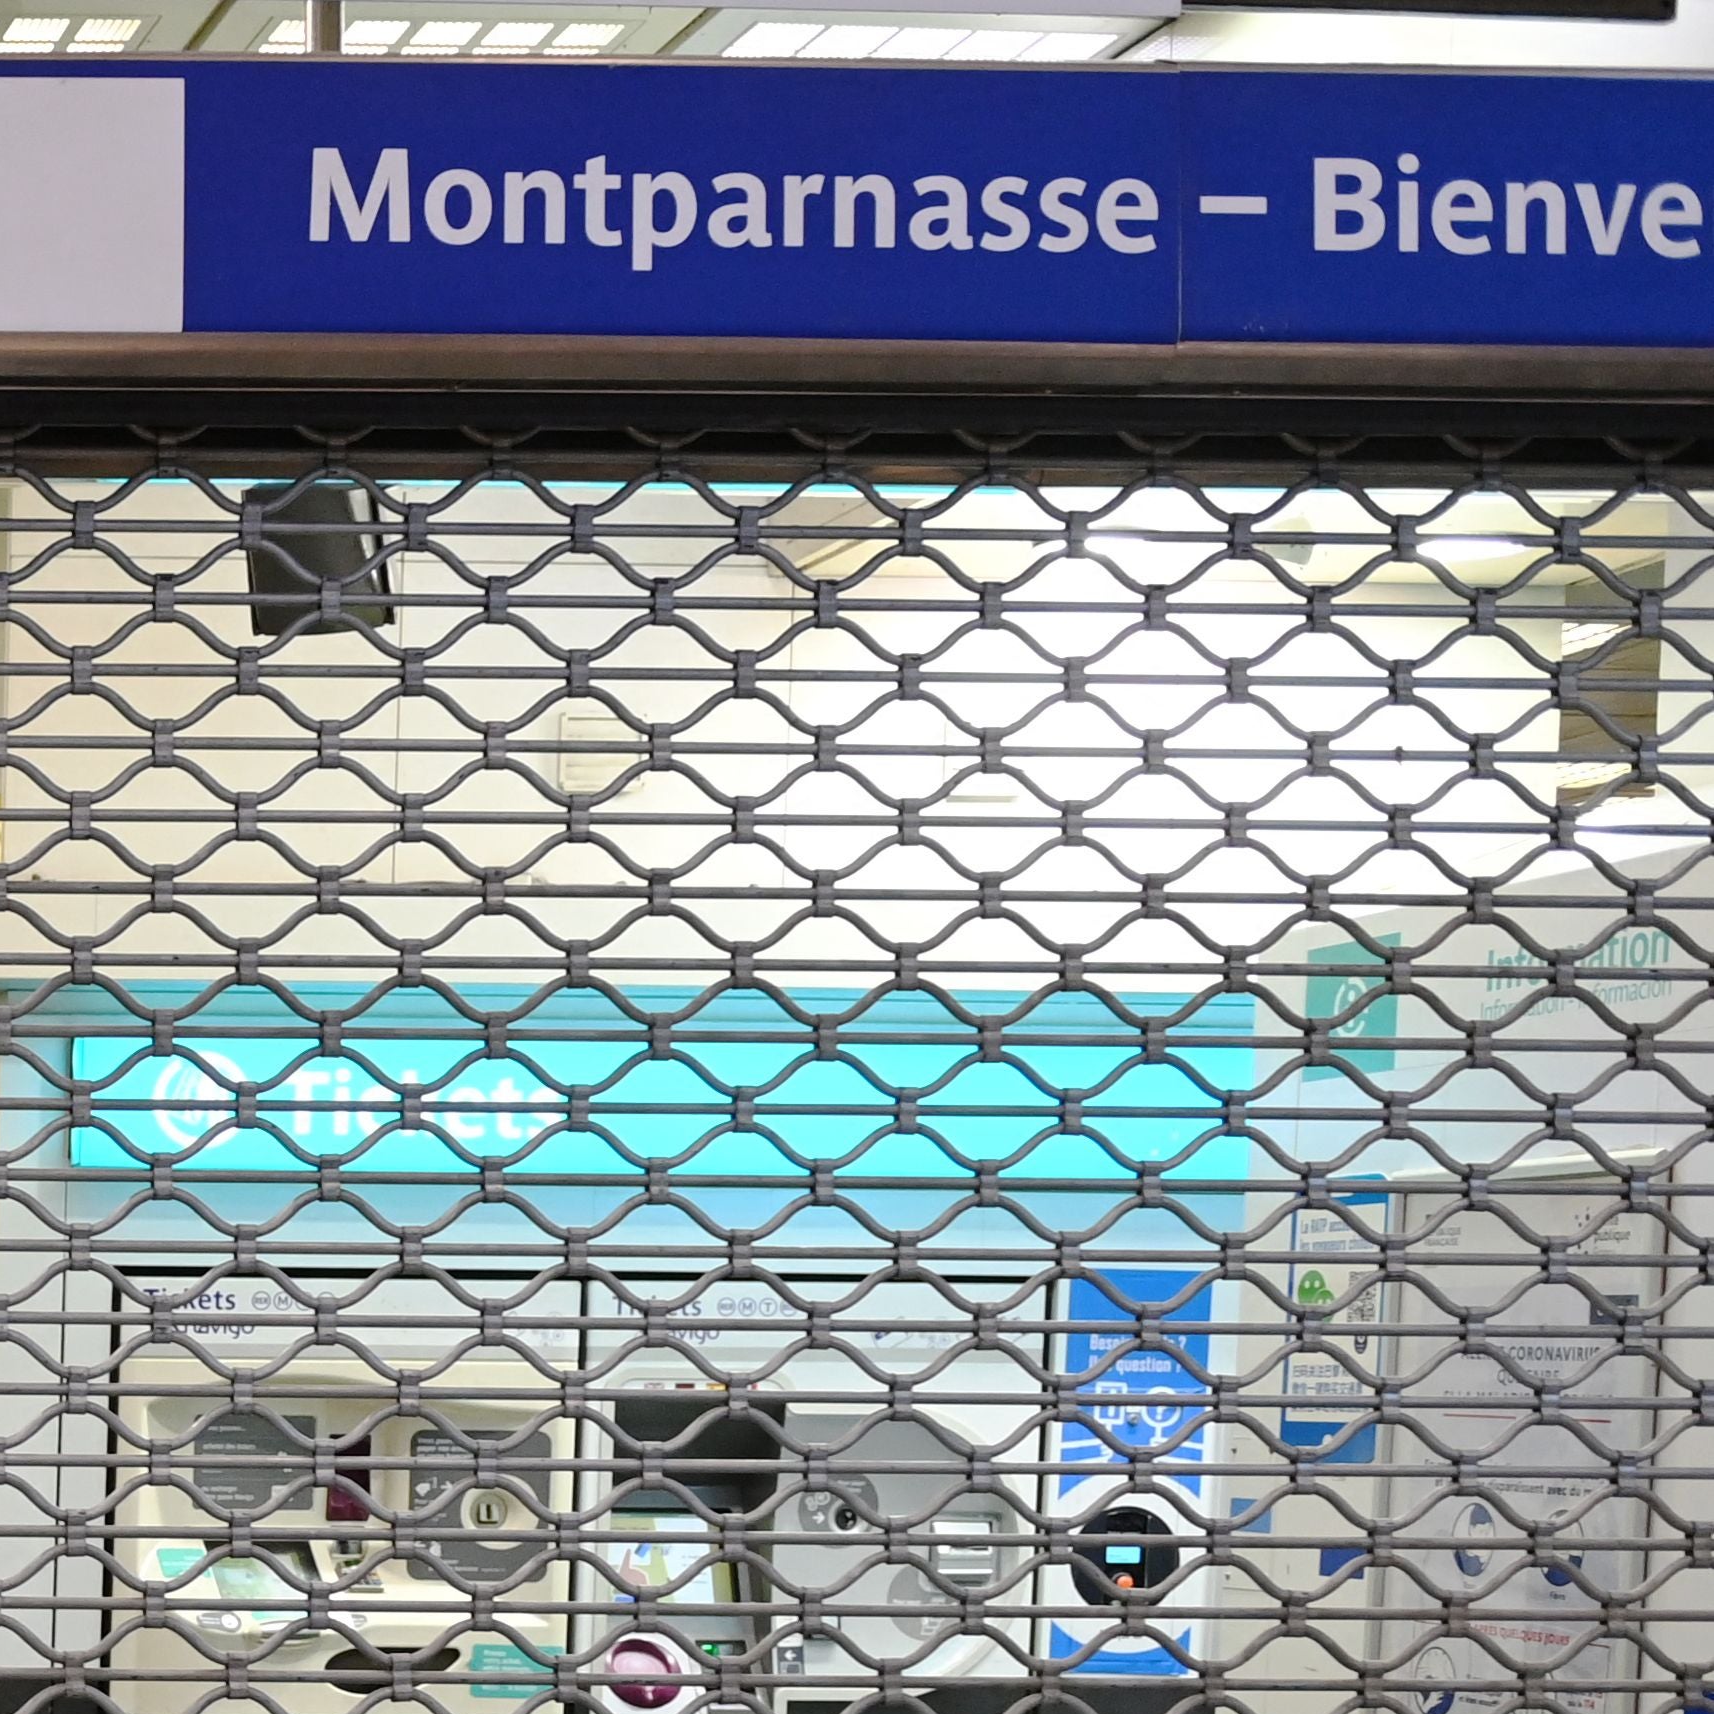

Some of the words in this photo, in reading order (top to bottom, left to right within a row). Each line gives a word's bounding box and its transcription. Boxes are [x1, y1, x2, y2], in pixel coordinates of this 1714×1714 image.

[308, 146, 1160, 272] Montparnasse
[1312, 152, 1704, 259] Bienve
[1485, 930, 1671, 992] Infoation
[1480, 996, 1565, 1021] Infoation
[1576, 979, 1672, 1009] formación
[143, 1287, 236, 1311] Tkets
[612, 1295, 703, 1318] Tiets
[1115, 1354, 1172, 1375] question
[1509, 1345, 1602, 1363] CORONAVIRUS
[1546, 1486, 1568, 1498] avec
